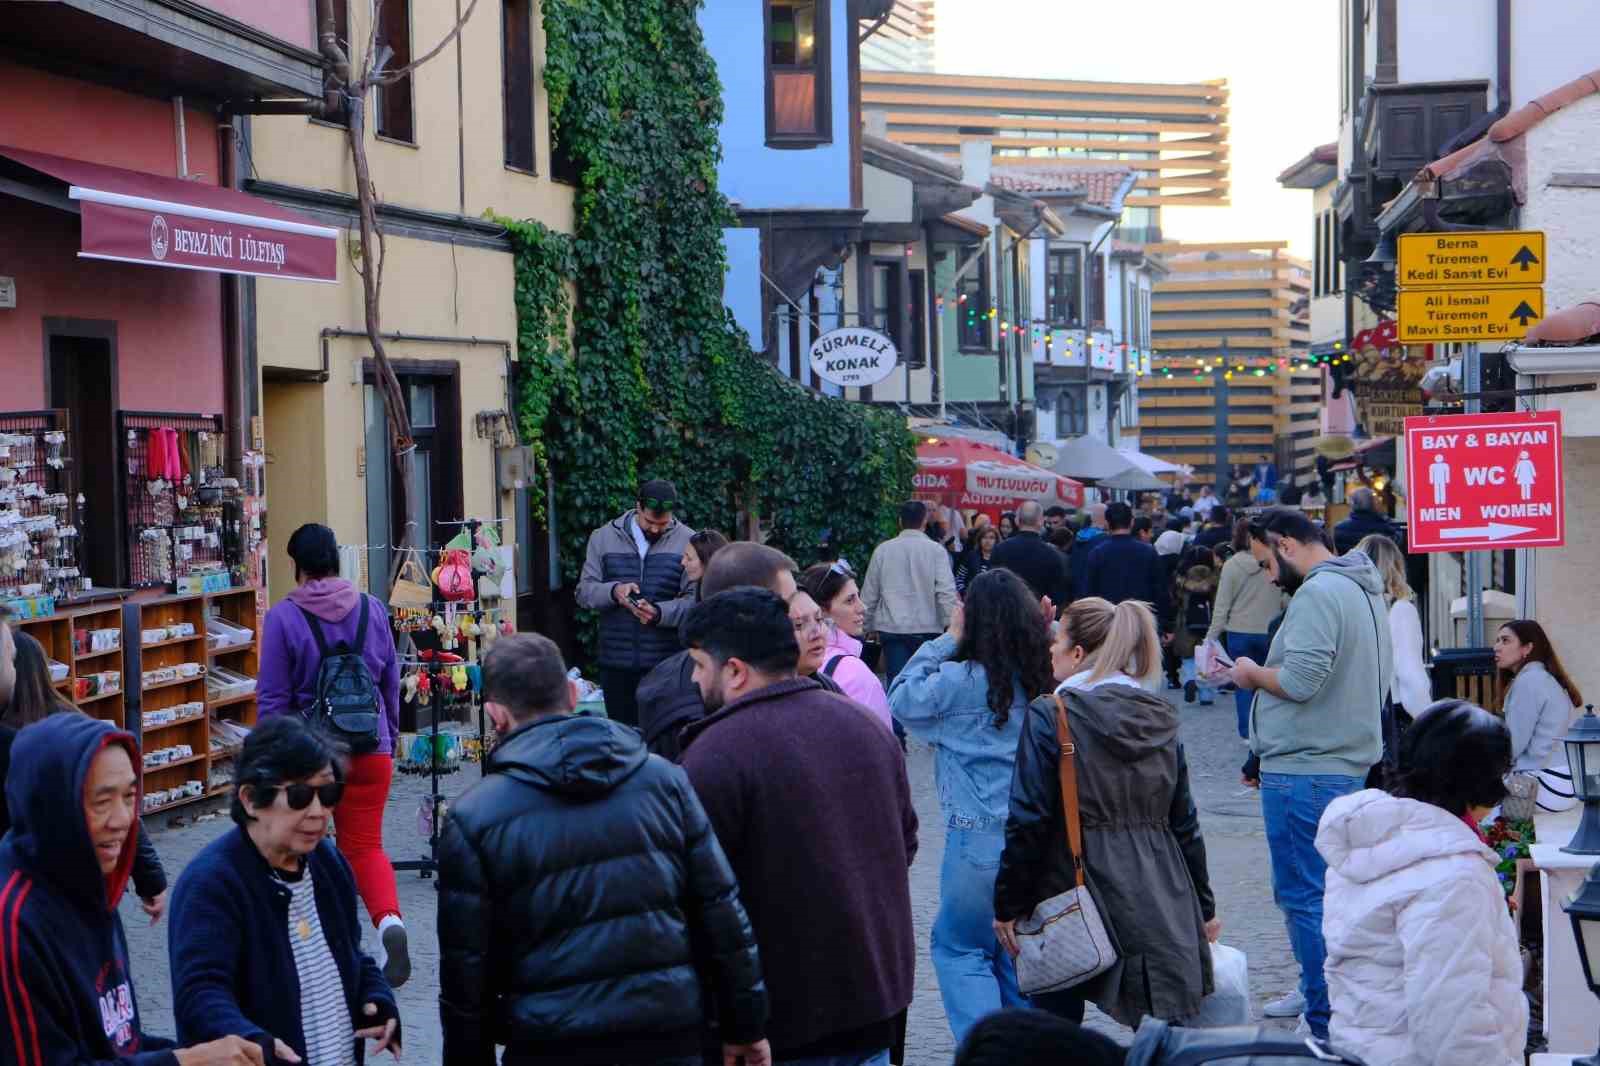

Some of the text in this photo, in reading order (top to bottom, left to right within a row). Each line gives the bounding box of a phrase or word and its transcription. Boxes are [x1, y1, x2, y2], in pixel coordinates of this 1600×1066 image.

[174, 228, 208, 255] BEYAZ
[210, 227, 233, 258] İNCİ
[1437, 239, 1478, 249] Berna
[1427, 253, 1488, 265] Türemen
[1407, 267, 1508, 280] Kedi Sanat Evi
[1425, 295, 1443, 306] Ali
[1427, 308, 1488, 320] Türemen
[1407, 323, 1508, 335] Mavi Sanat Evi
[813, 335, 890, 360] SÜRMELİ
[826, 356, 880, 372] KONAK
[1421, 430, 1548, 450] BAY & BAYAN
[1463, 466, 1506, 486] WC
[1420, 502, 1552, 522] MEN WOMEN
